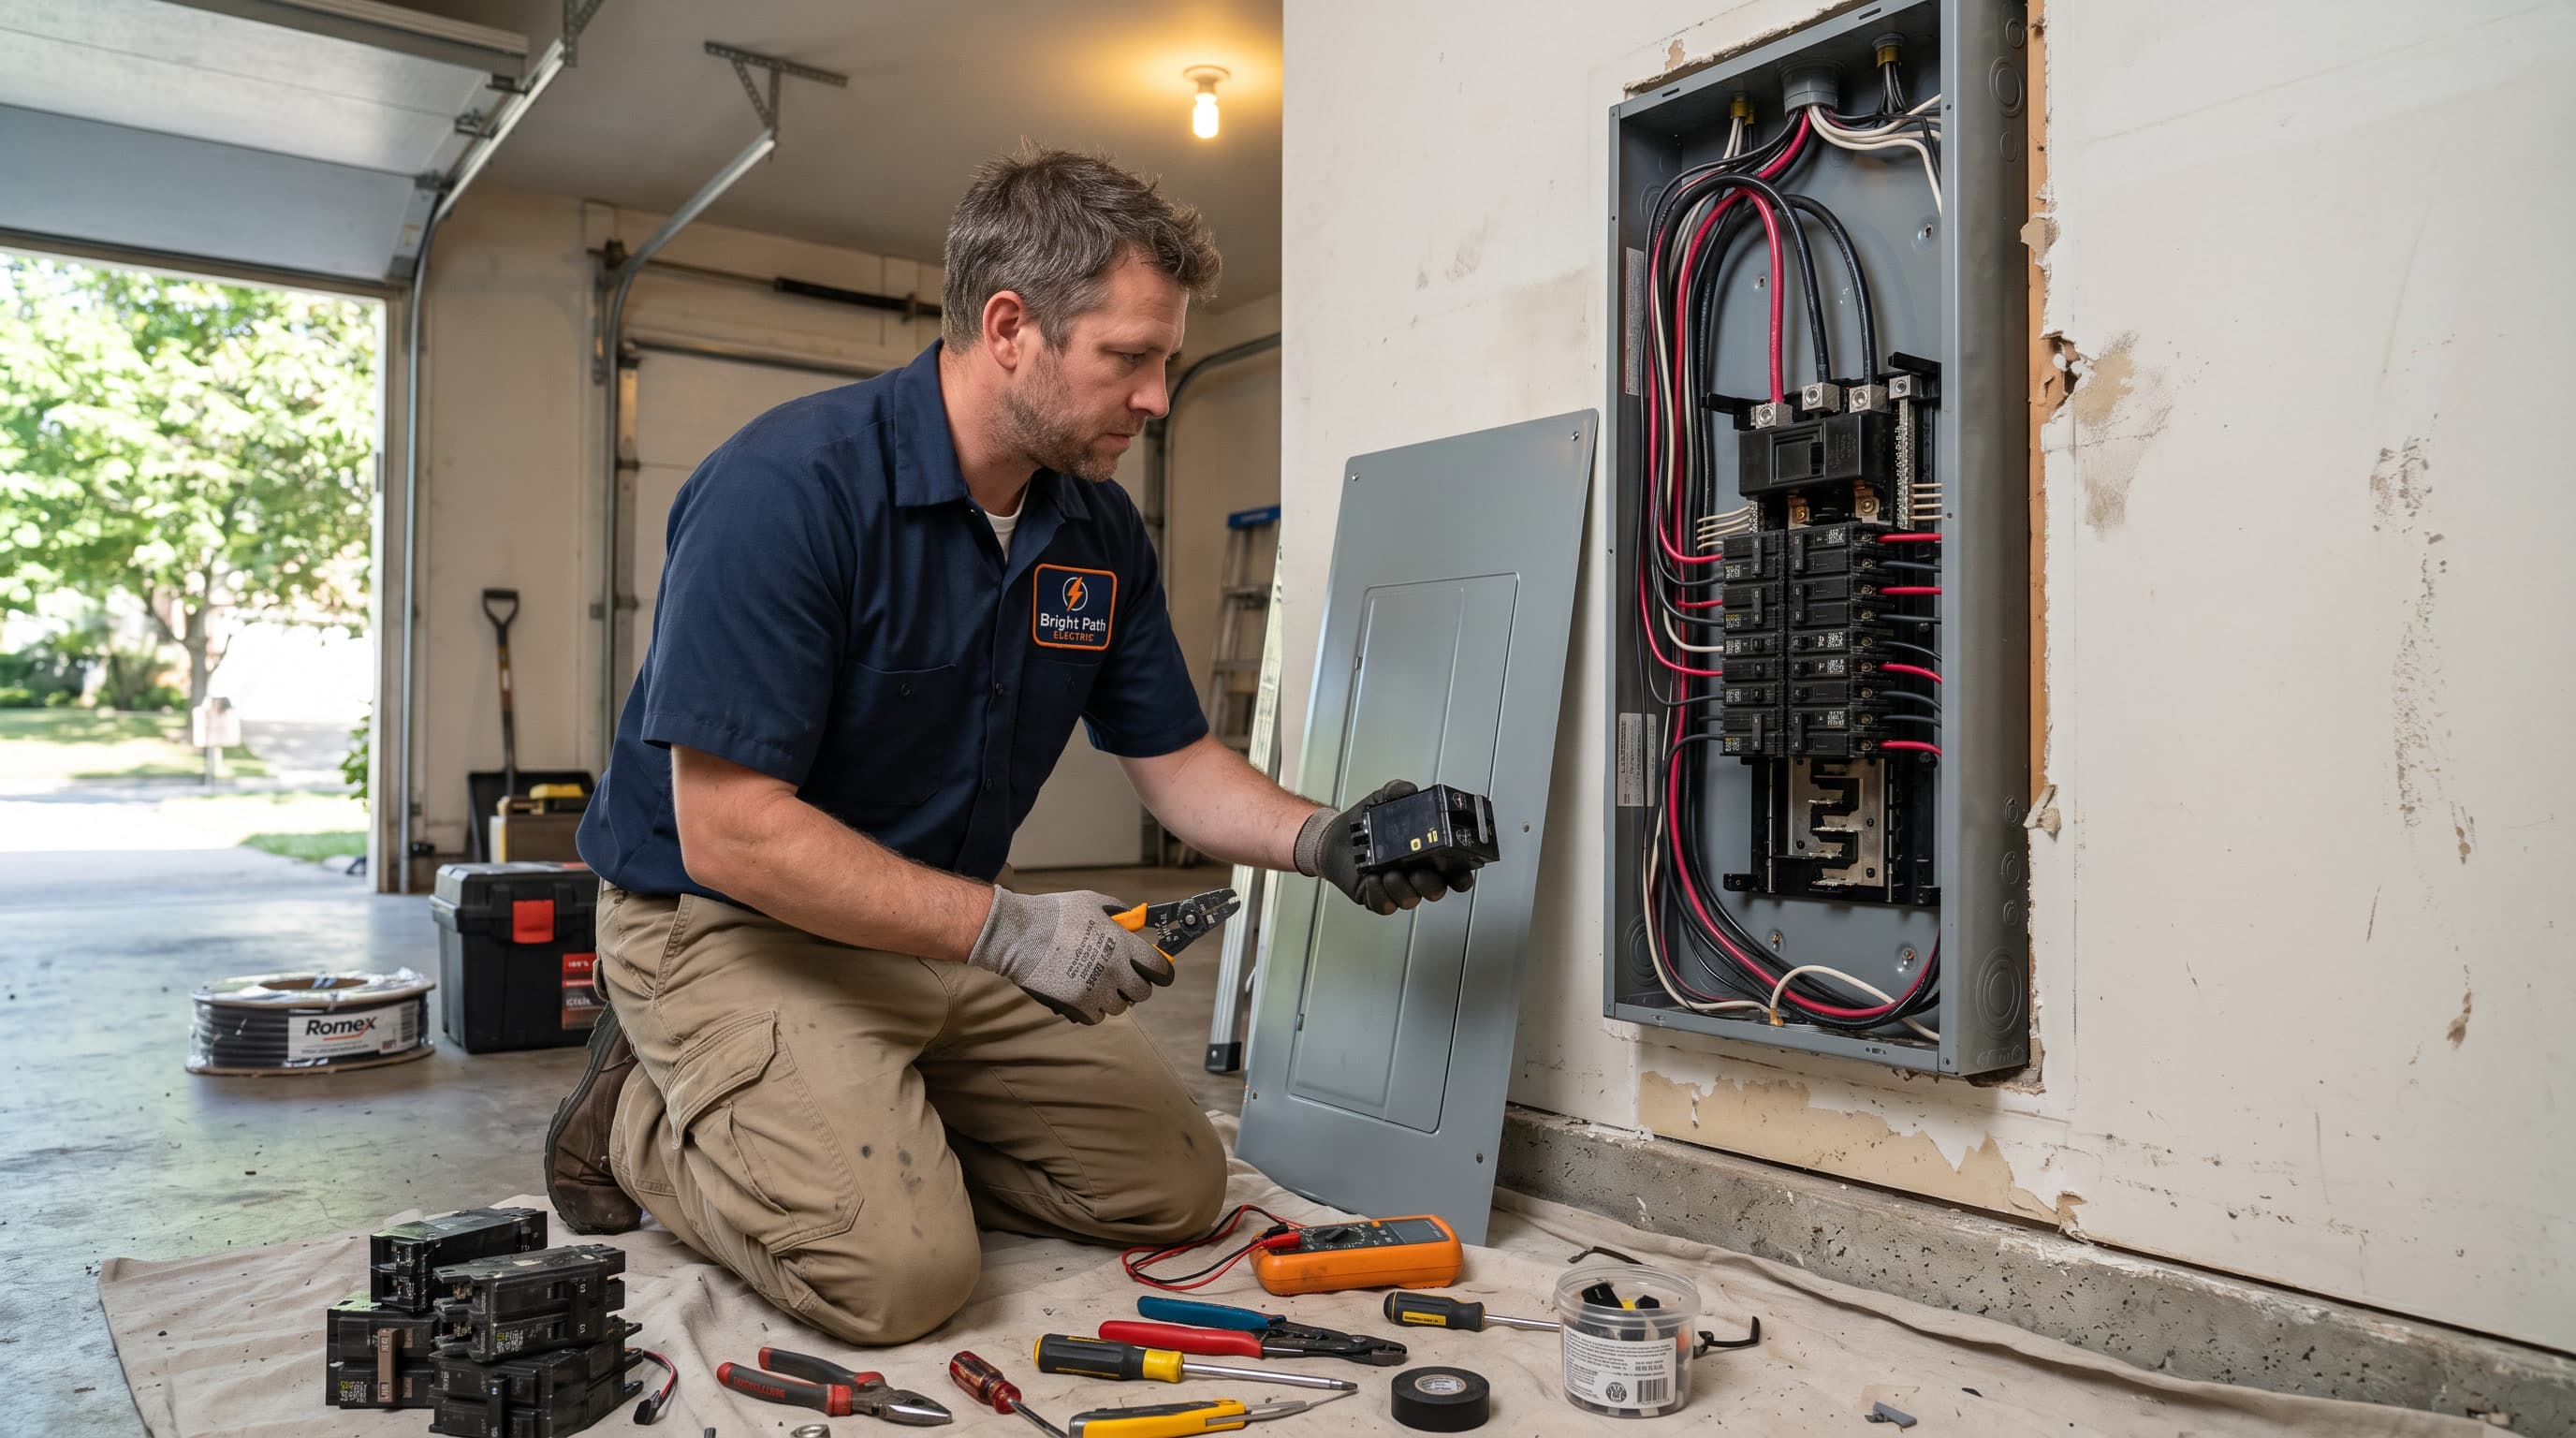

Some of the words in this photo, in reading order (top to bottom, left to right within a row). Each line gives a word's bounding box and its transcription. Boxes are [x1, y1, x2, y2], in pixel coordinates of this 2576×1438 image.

[1040, 613, 1079, 631] Bright
[1082, 617, 1106, 632] Path
[1053, 631, 1094, 642] ELECTRIC
[305, 1016, 378, 1036] Romex
